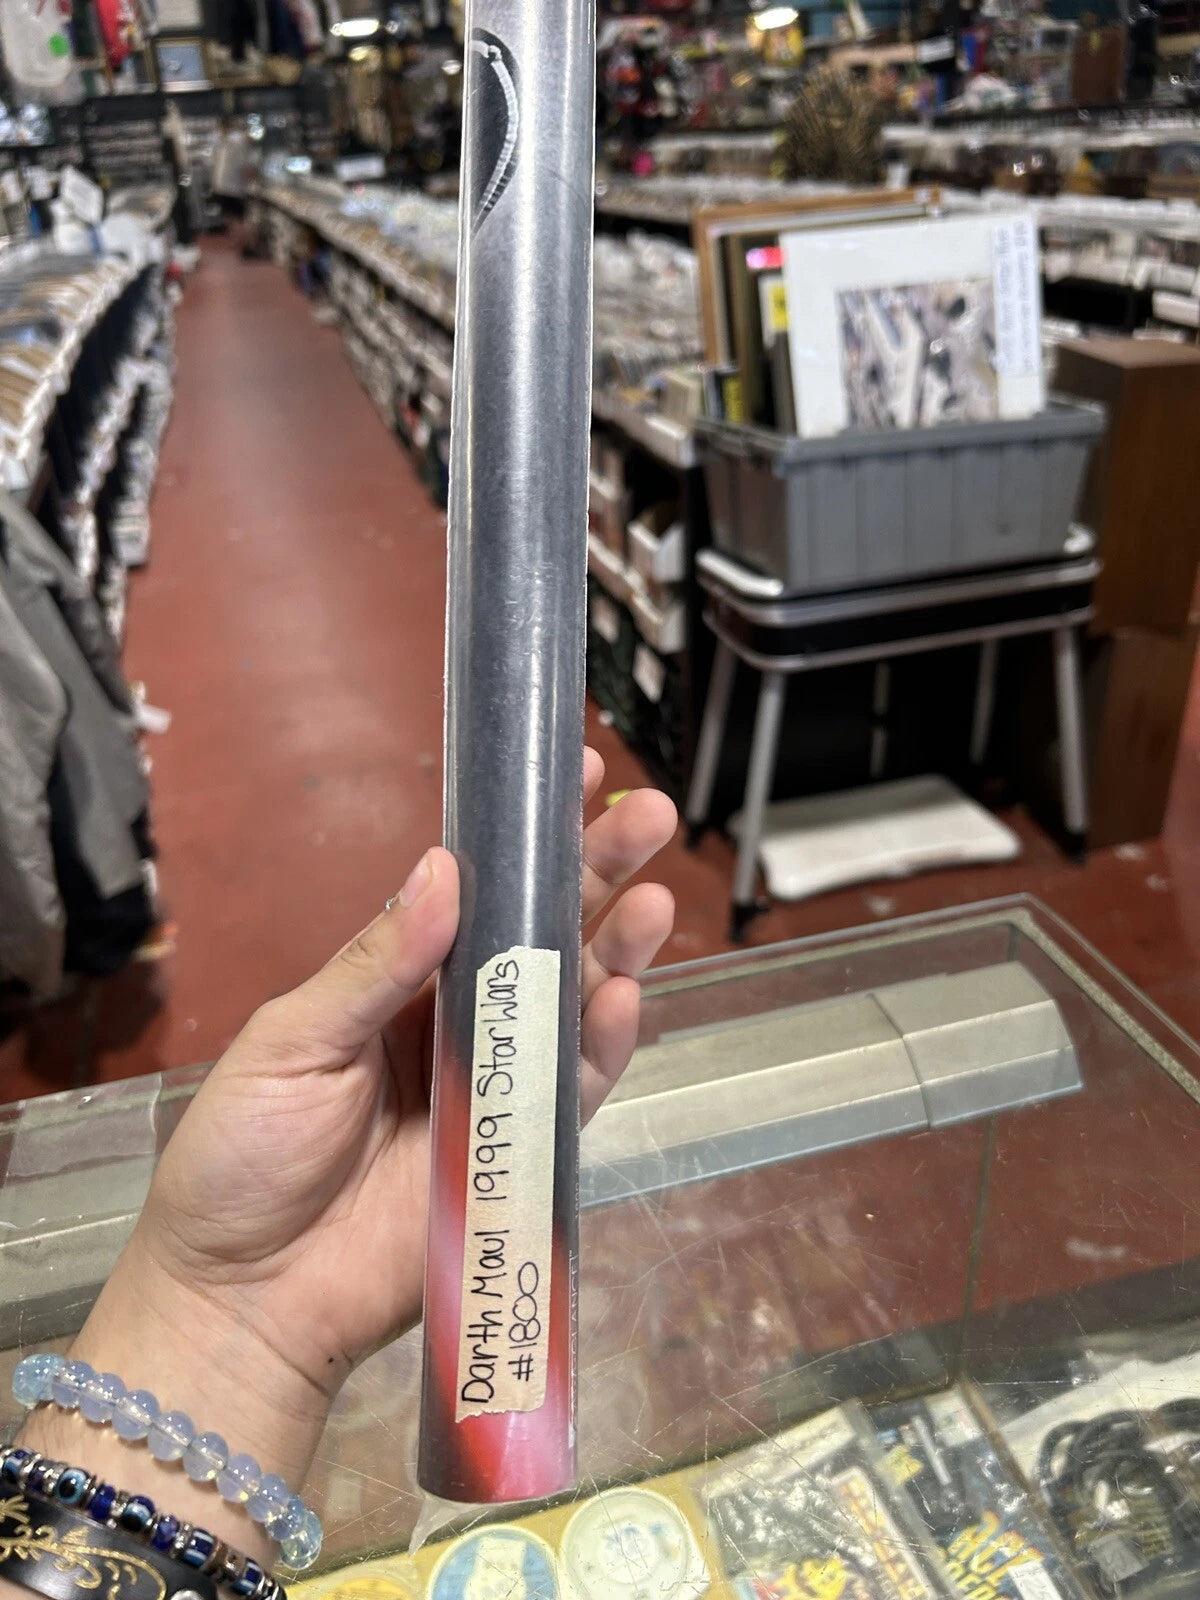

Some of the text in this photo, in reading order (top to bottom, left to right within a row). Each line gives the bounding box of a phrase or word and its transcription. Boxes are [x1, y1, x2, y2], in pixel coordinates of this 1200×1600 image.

[461, 959, 520, 1403] Darth Maul 1999 Star Wars
[507, 1261, 541, 1382] #1800
